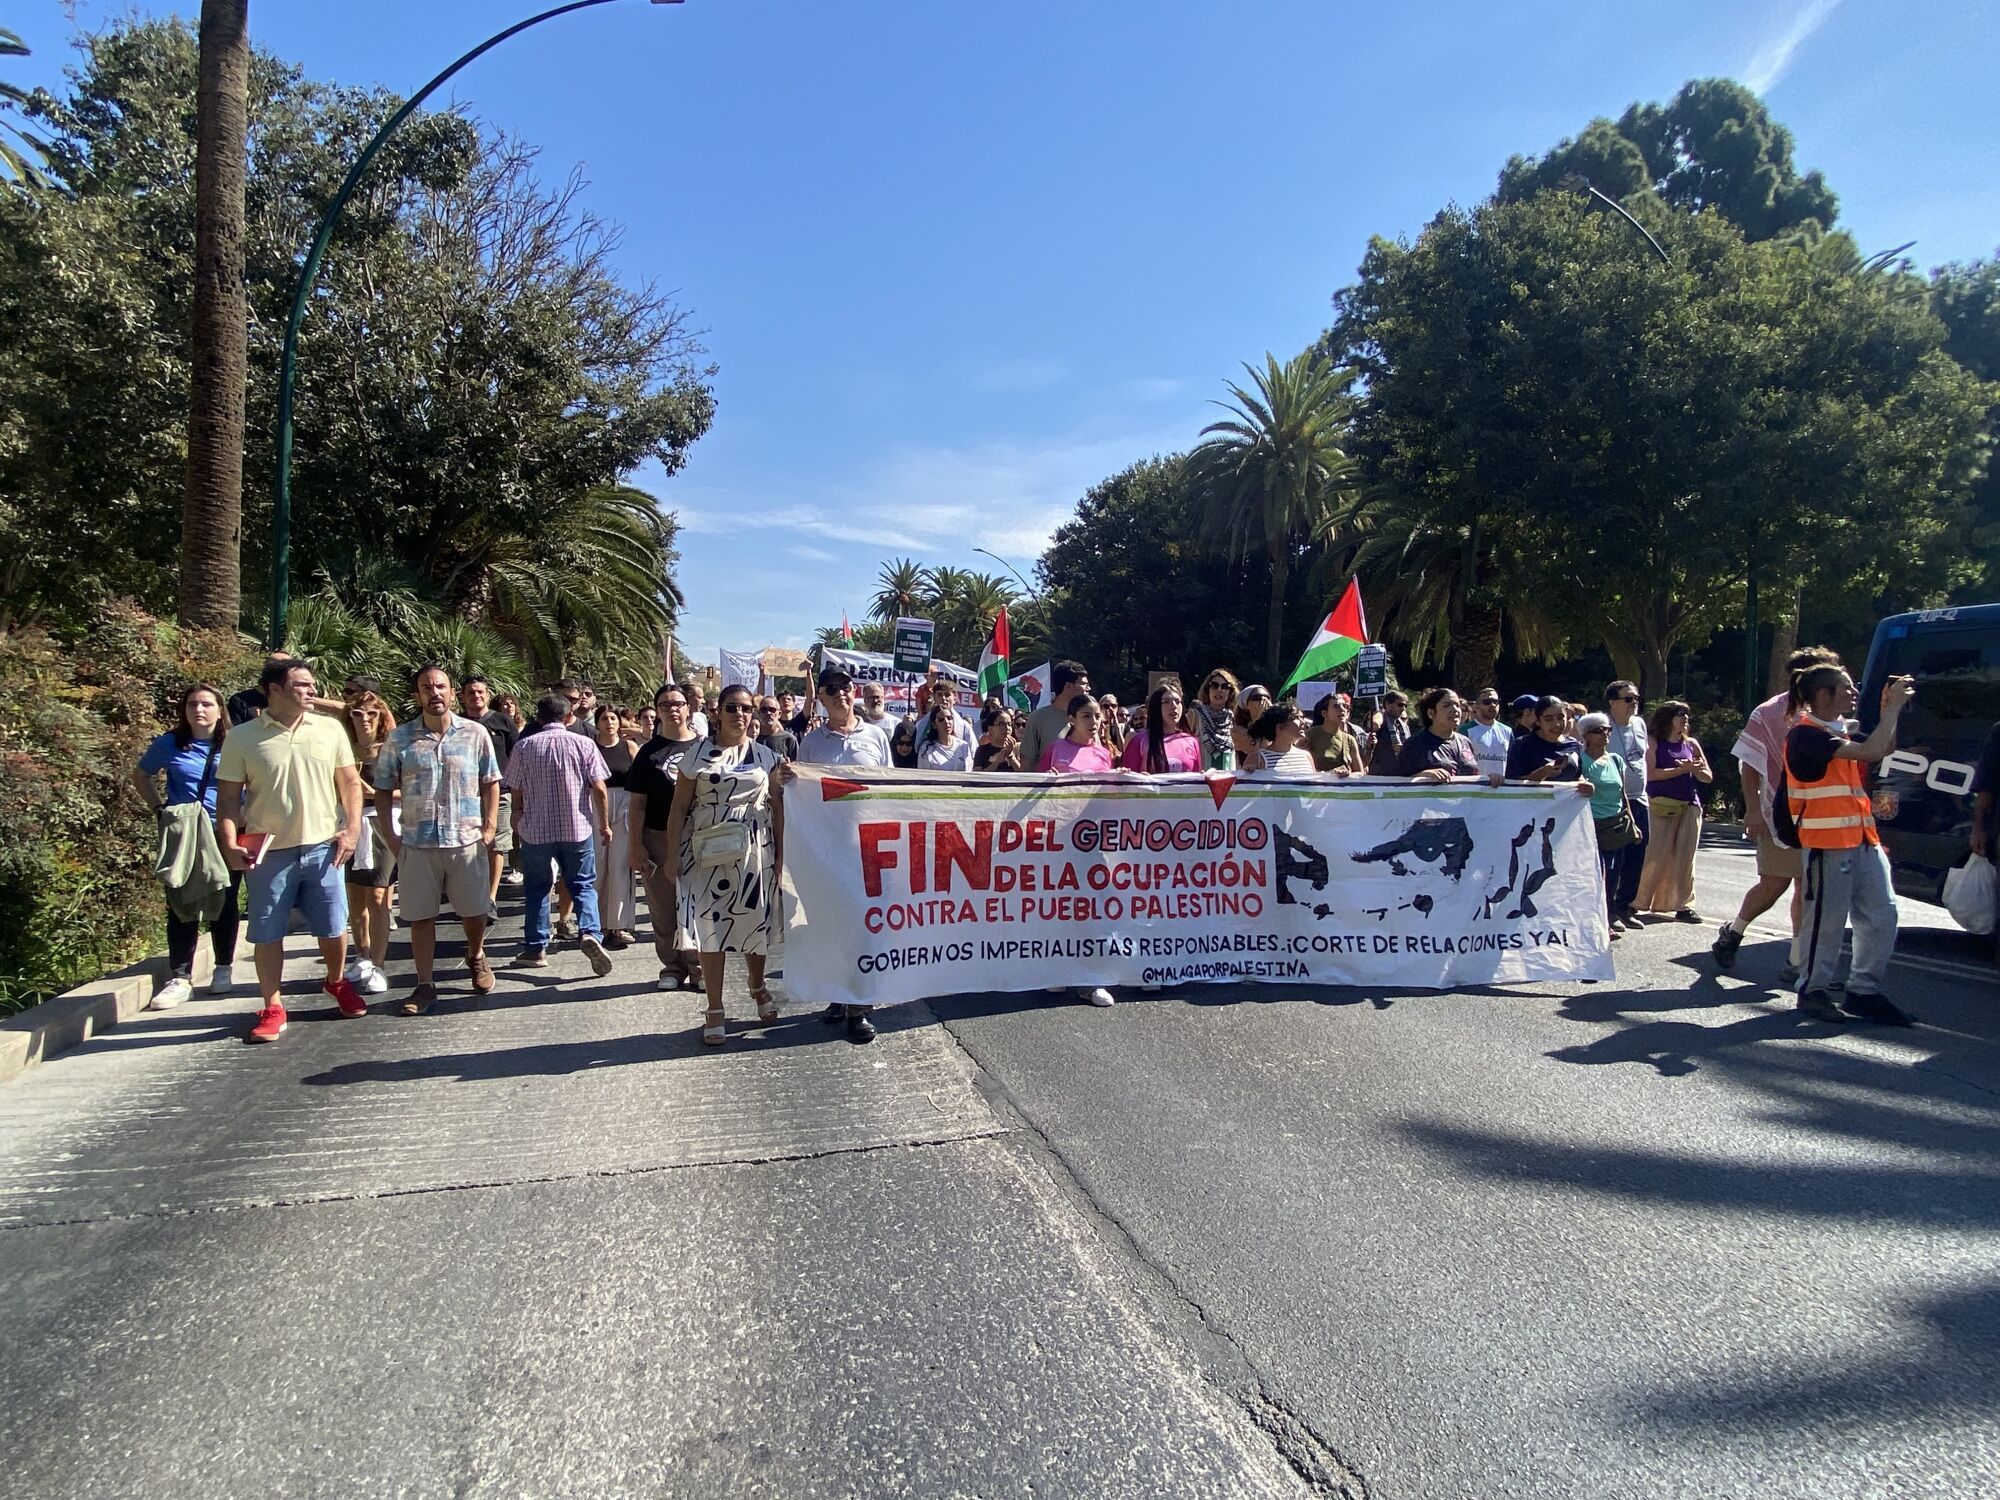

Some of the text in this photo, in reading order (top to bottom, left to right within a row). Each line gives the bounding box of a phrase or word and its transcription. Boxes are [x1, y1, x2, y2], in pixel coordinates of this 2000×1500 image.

[1879, 750, 1976, 796] PO
[998, 817, 1269, 852] DEL GENOCIDIO
[858, 820, 994, 898] FIN
[993, 851, 1267, 893] DE LA OCUPACIÓN
[864, 892, 1264, 934] CONTRA EL PUEBLO PALESTINO
[857, 941, 974, 974] GOBIERNOS
[981, 936, 1133, 961] IMPERIALISTAS
[1373, 935, 1400, 954] DE
[1406, 931, 1524, 956] RELACIONES
[1529, 928, 1569, 948] YA!
[1142, 960, 1310, 984] @MALAGAPORPALESTINA
